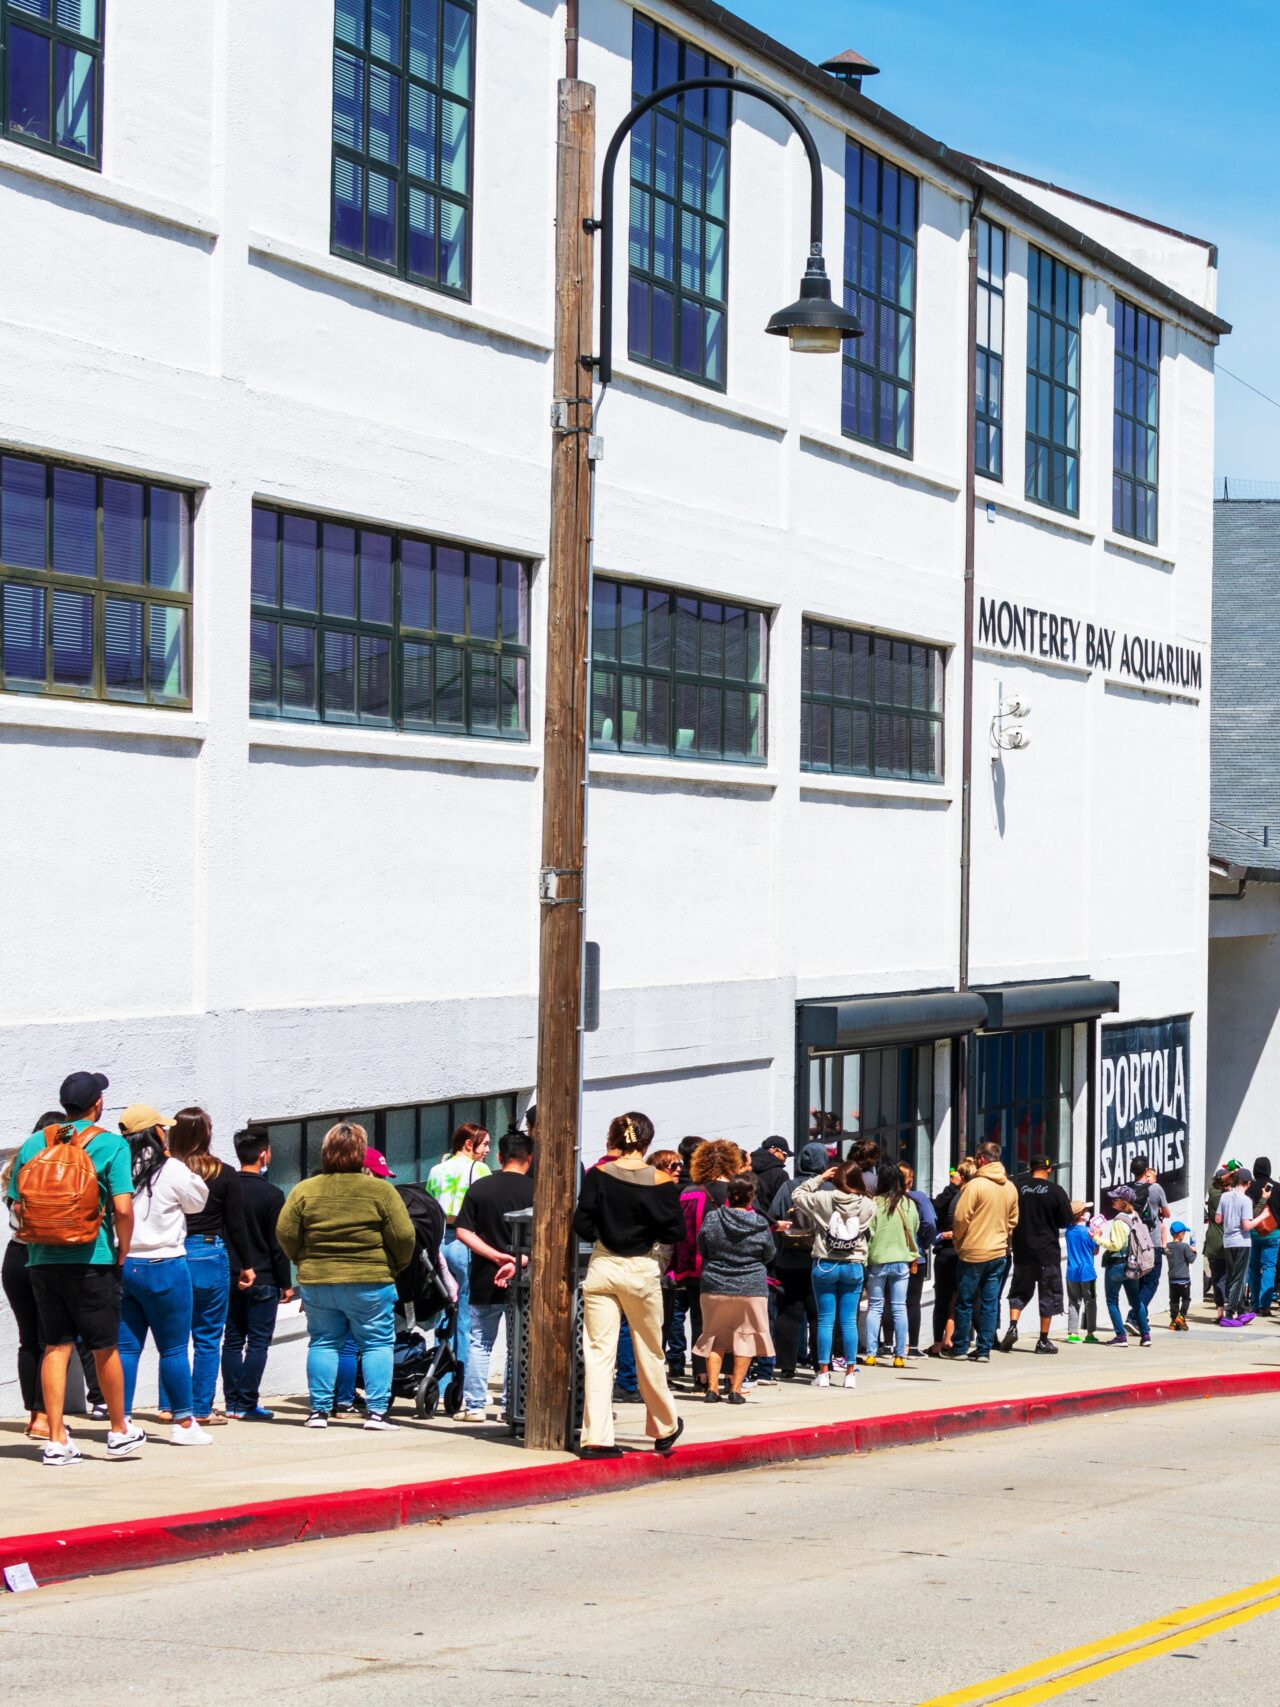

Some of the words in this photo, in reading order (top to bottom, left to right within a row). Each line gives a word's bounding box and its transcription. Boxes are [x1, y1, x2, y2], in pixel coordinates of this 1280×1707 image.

[978, 596, 1081, 663] MONTEREY
[1086, 623, 1115, 671] BAY
[1120, 634, 1202, 690] AQUARIUM
[1101, 1046, 1188, 1142] PORTOLA
[1134, 1117, 1157, 1136] BRAND
